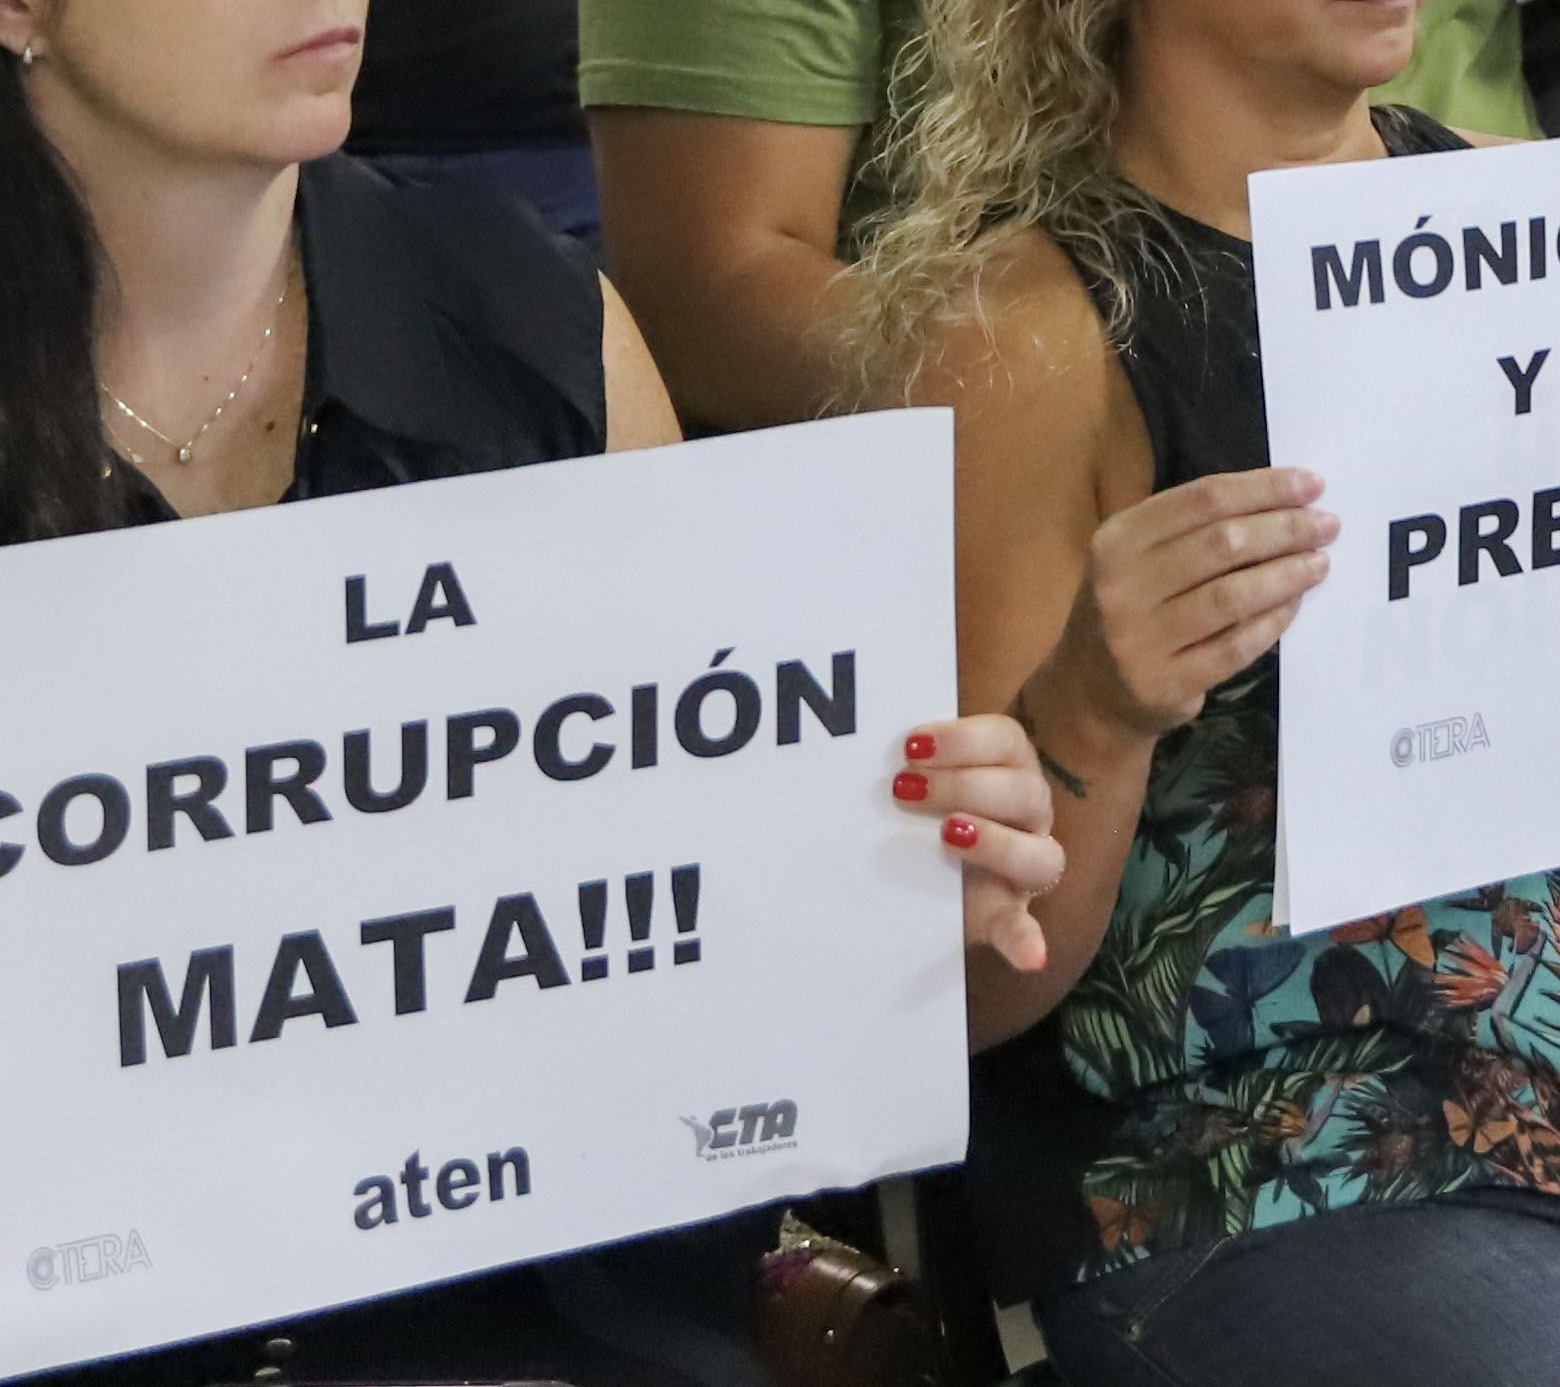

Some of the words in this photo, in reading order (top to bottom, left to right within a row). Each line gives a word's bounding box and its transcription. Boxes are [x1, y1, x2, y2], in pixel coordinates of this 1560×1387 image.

[1496, 348, 1551, 416] Y
[345, 561, 477, 644] LA
[117, 863, 701, 1068] MATA!!!
[709, 1098, 798, 1149] CTA
[353, 1147, 531, 1230] aten
